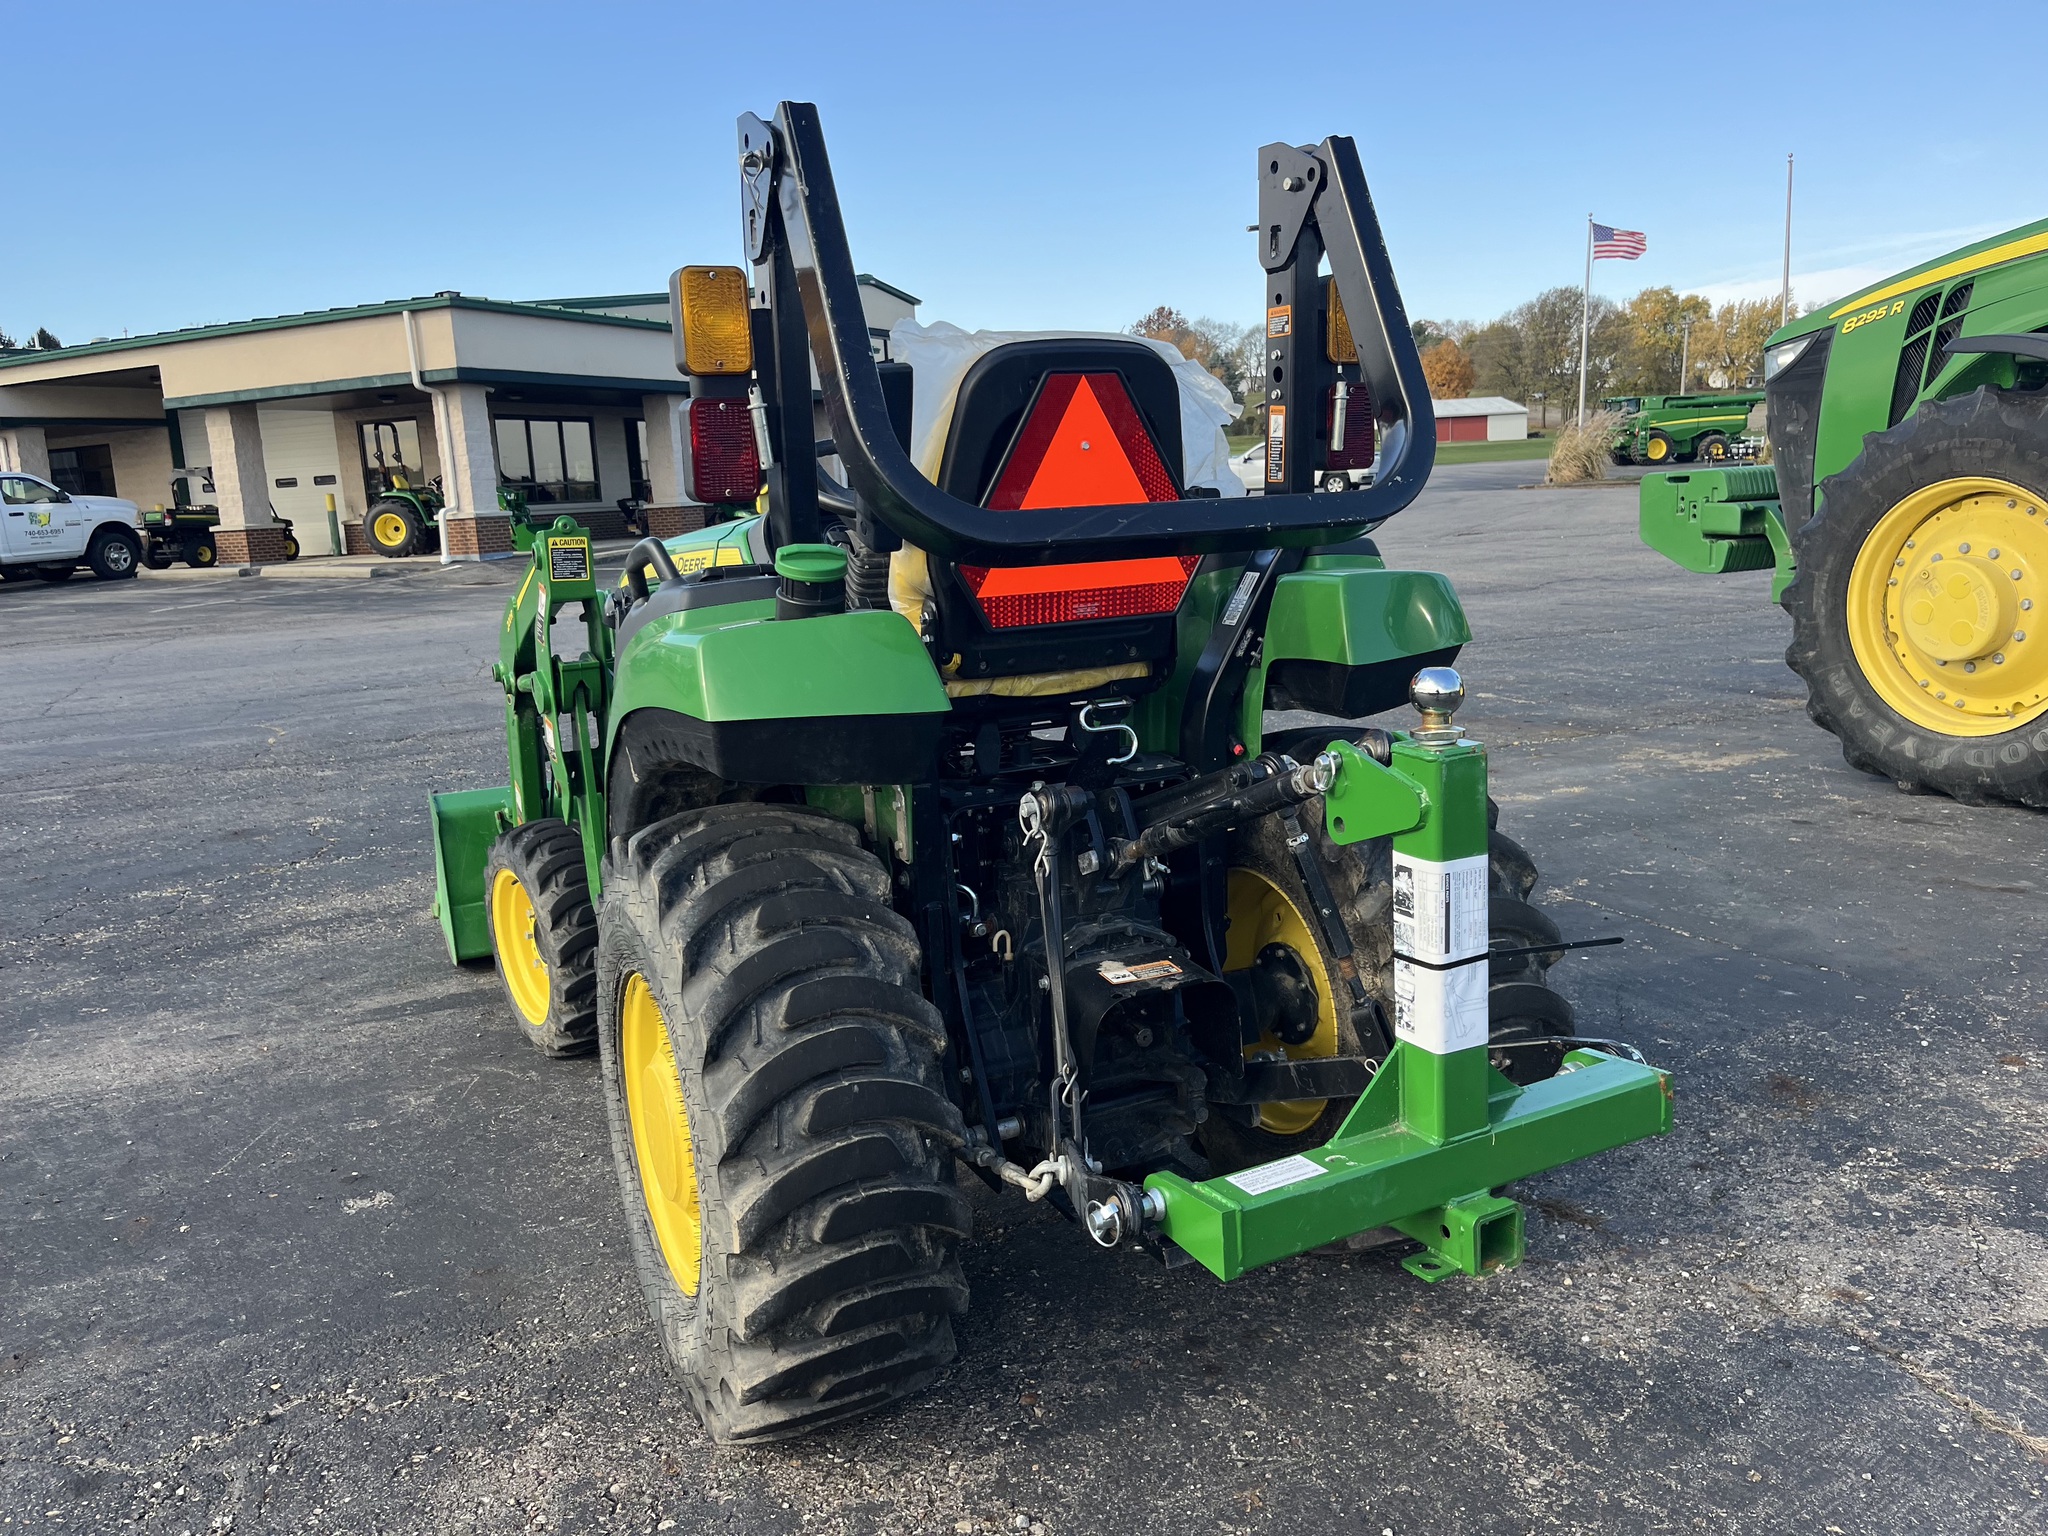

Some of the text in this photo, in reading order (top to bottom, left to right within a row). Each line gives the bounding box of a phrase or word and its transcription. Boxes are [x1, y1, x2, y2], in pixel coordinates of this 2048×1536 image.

[1841, 300, 1905, 334] 8295 R
[559, 539, 586, 547] CAUTION
[678, 557, 707, 572] DEERE
[1272, 1158, 1296, 1167] Capacity
